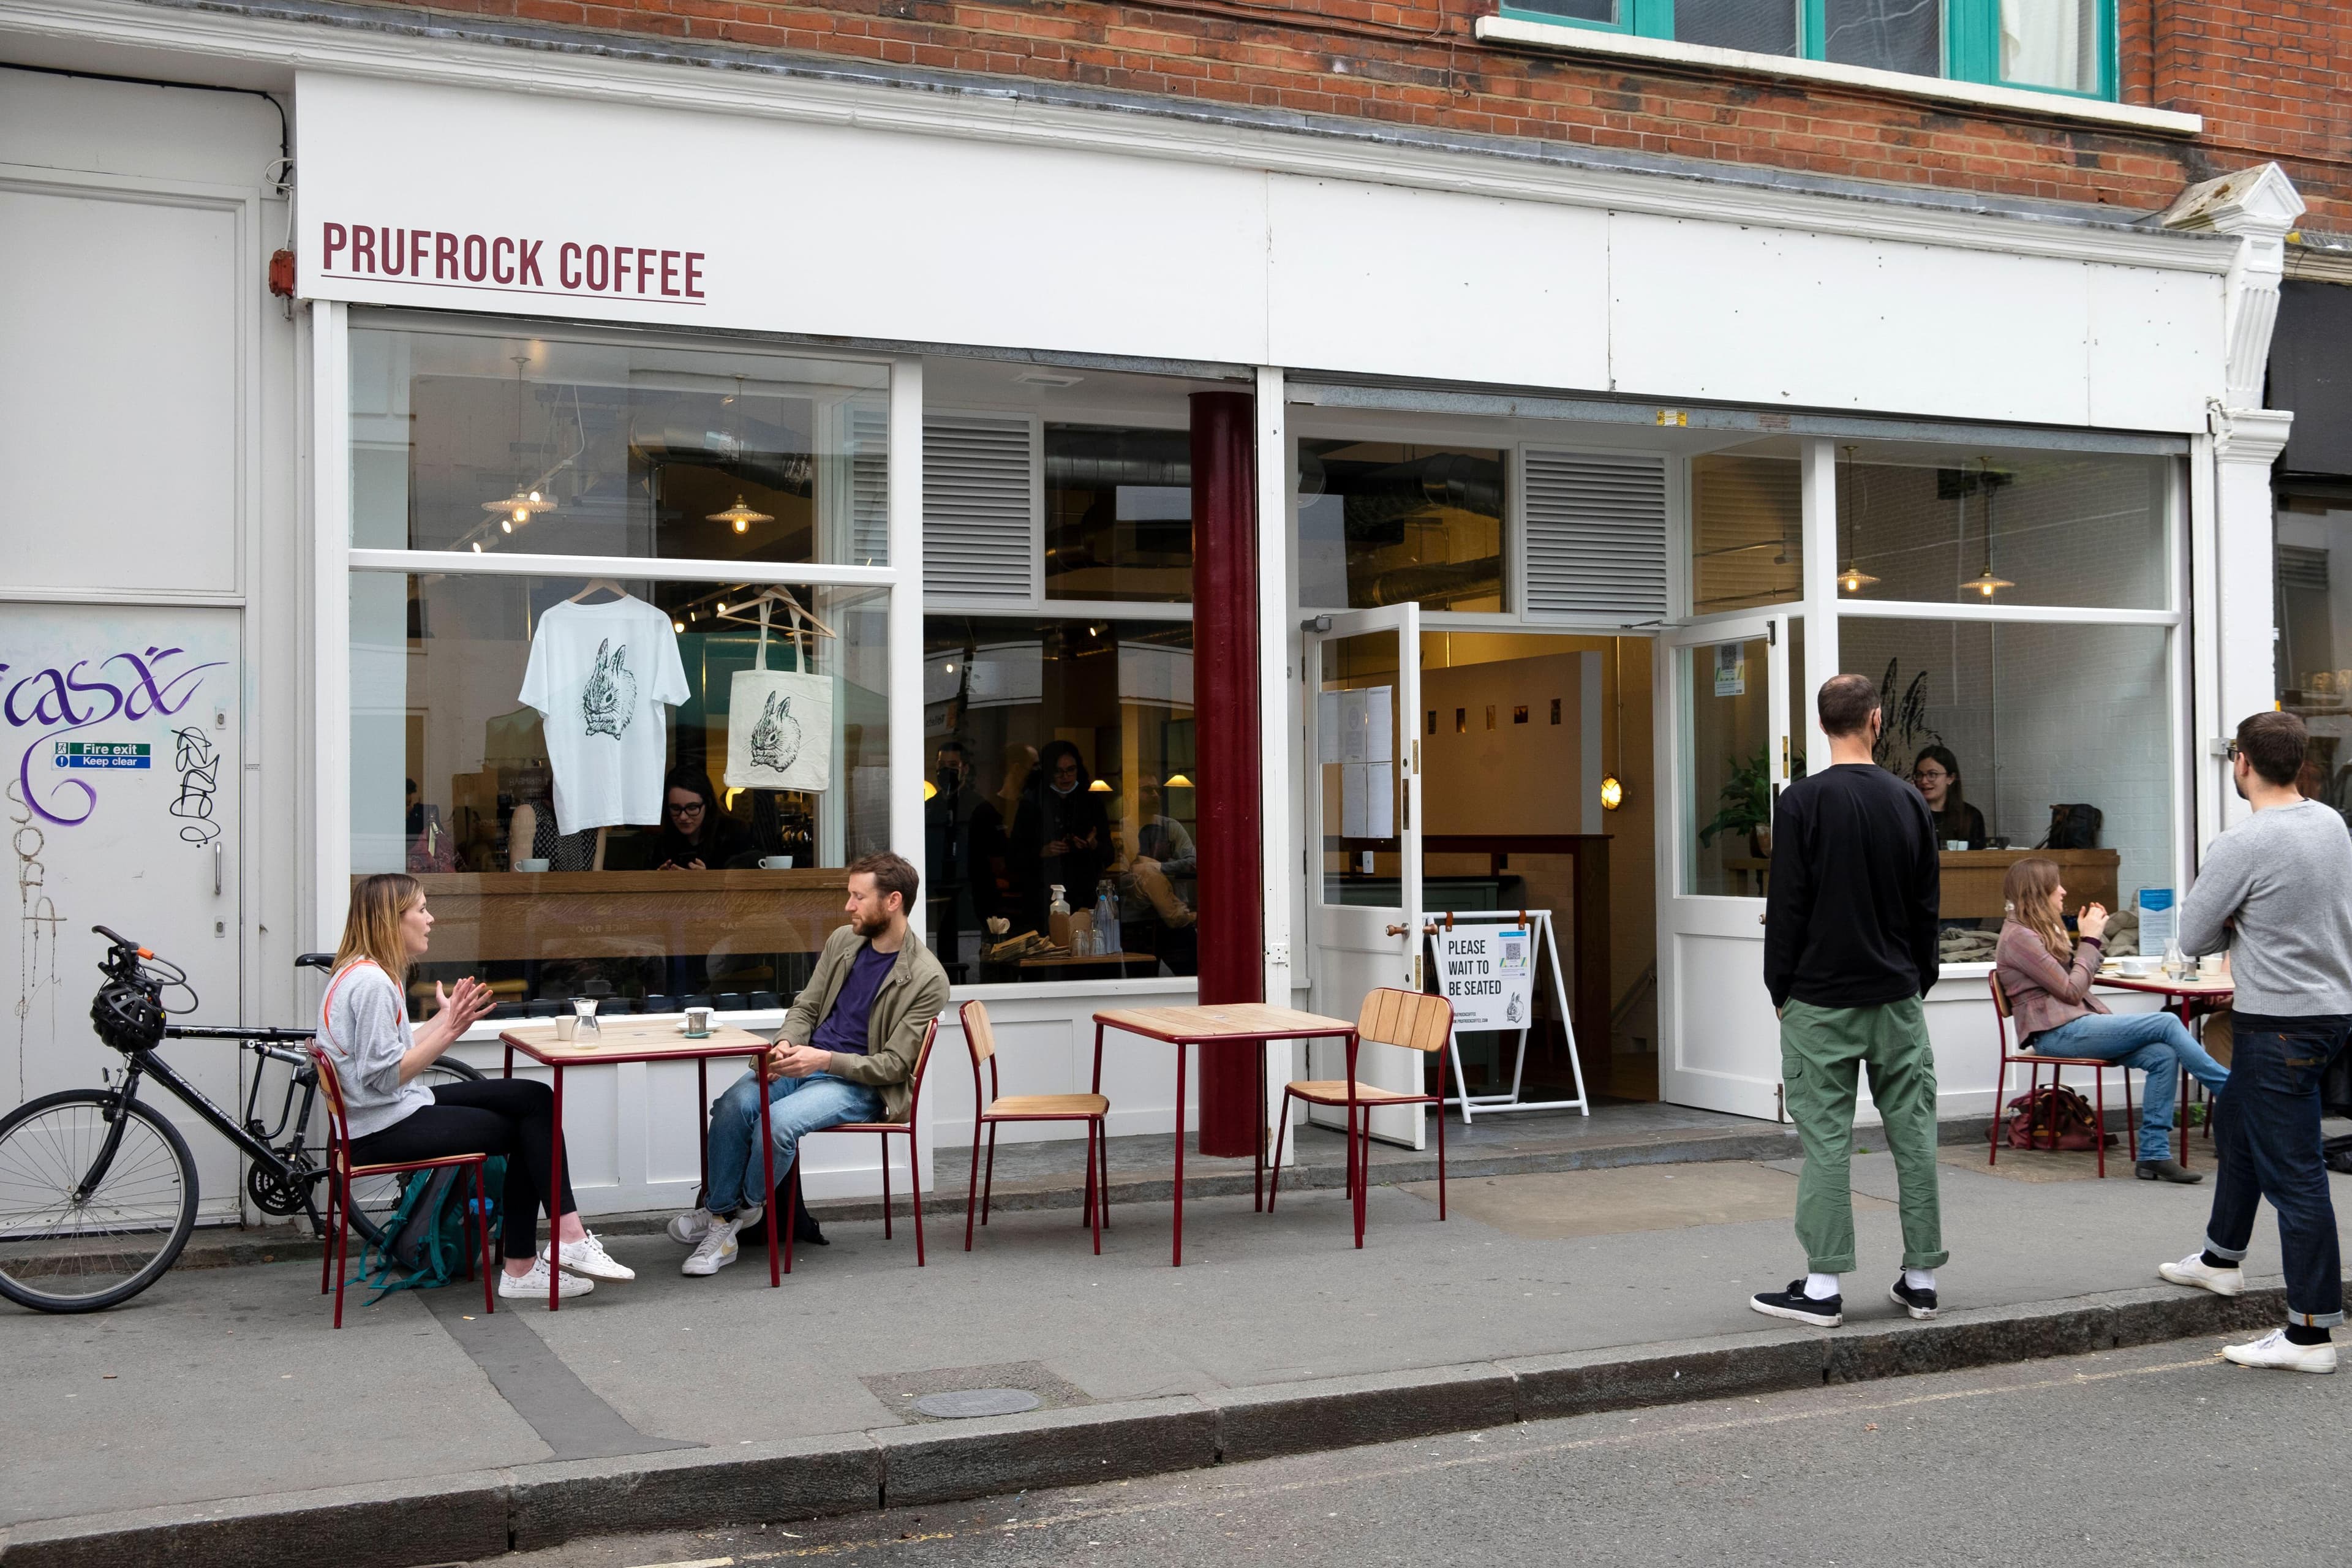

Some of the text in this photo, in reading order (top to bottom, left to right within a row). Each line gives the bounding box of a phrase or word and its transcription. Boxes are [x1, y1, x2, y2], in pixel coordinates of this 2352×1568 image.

[323, 222, 705, 298] PRUFROCK COFFEE
[83, 744, 137, 755] Fire exit
[83, 756, 137, 767] Keep clear
[1449, 940, 1485, 955] PLEASE
[1449, 960, 1474, 975] WAIT
[1476, 960, 1489, 974] TO
[1449, 980, 1501, 996] BE SEATED
